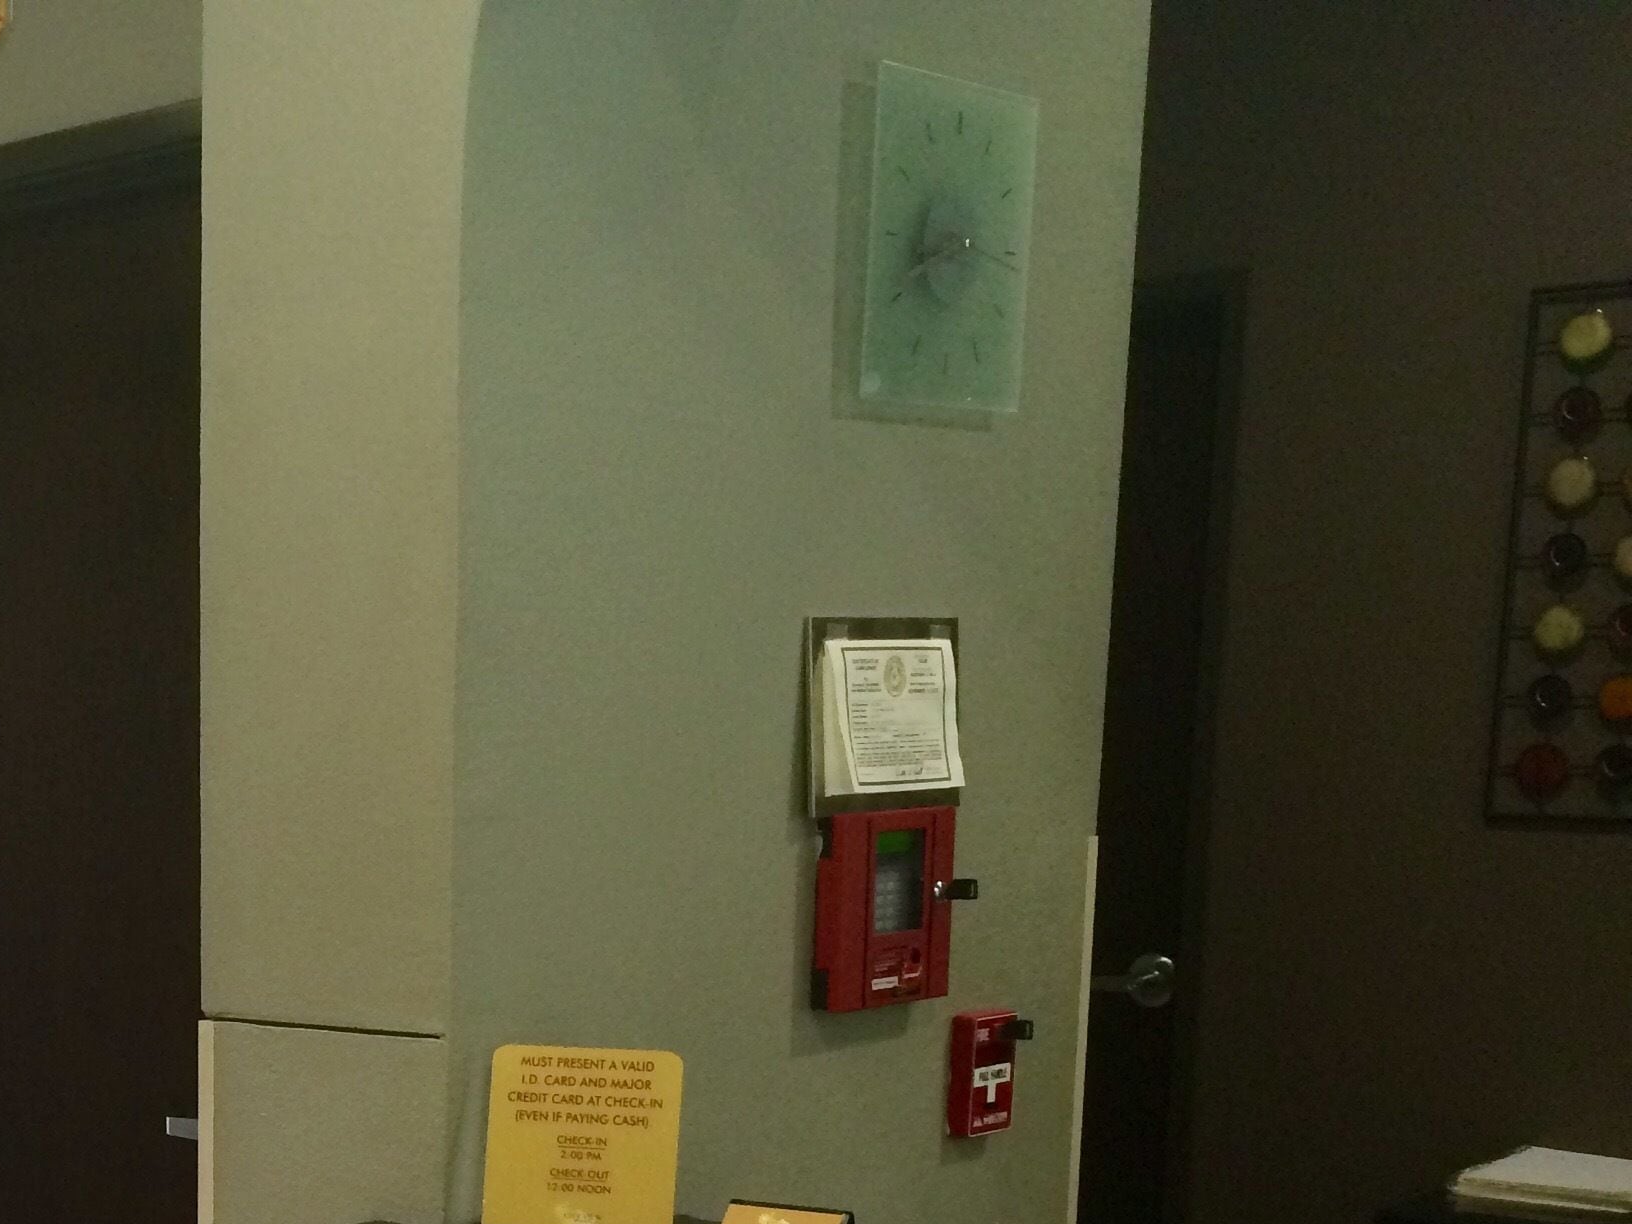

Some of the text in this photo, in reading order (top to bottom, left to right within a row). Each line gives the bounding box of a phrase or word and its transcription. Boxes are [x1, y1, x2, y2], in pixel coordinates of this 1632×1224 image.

[520, 1056, 655, 1072] MUST PRESENT A VALID
[544, 1074, 577, 1086] CARD
[579, 1077, 608, 1088] AND
[610, 1078, 653, 1090] MAJOR
[507, 1091, 664, 1109] CREDIT CARD AT CHECK-IN
[515, 1109, 649, 1129] (EVEN IF PAYING CASH)
[586, 1151, 603, 1161] PM
[577, 1184, 612, 1194] NOON
